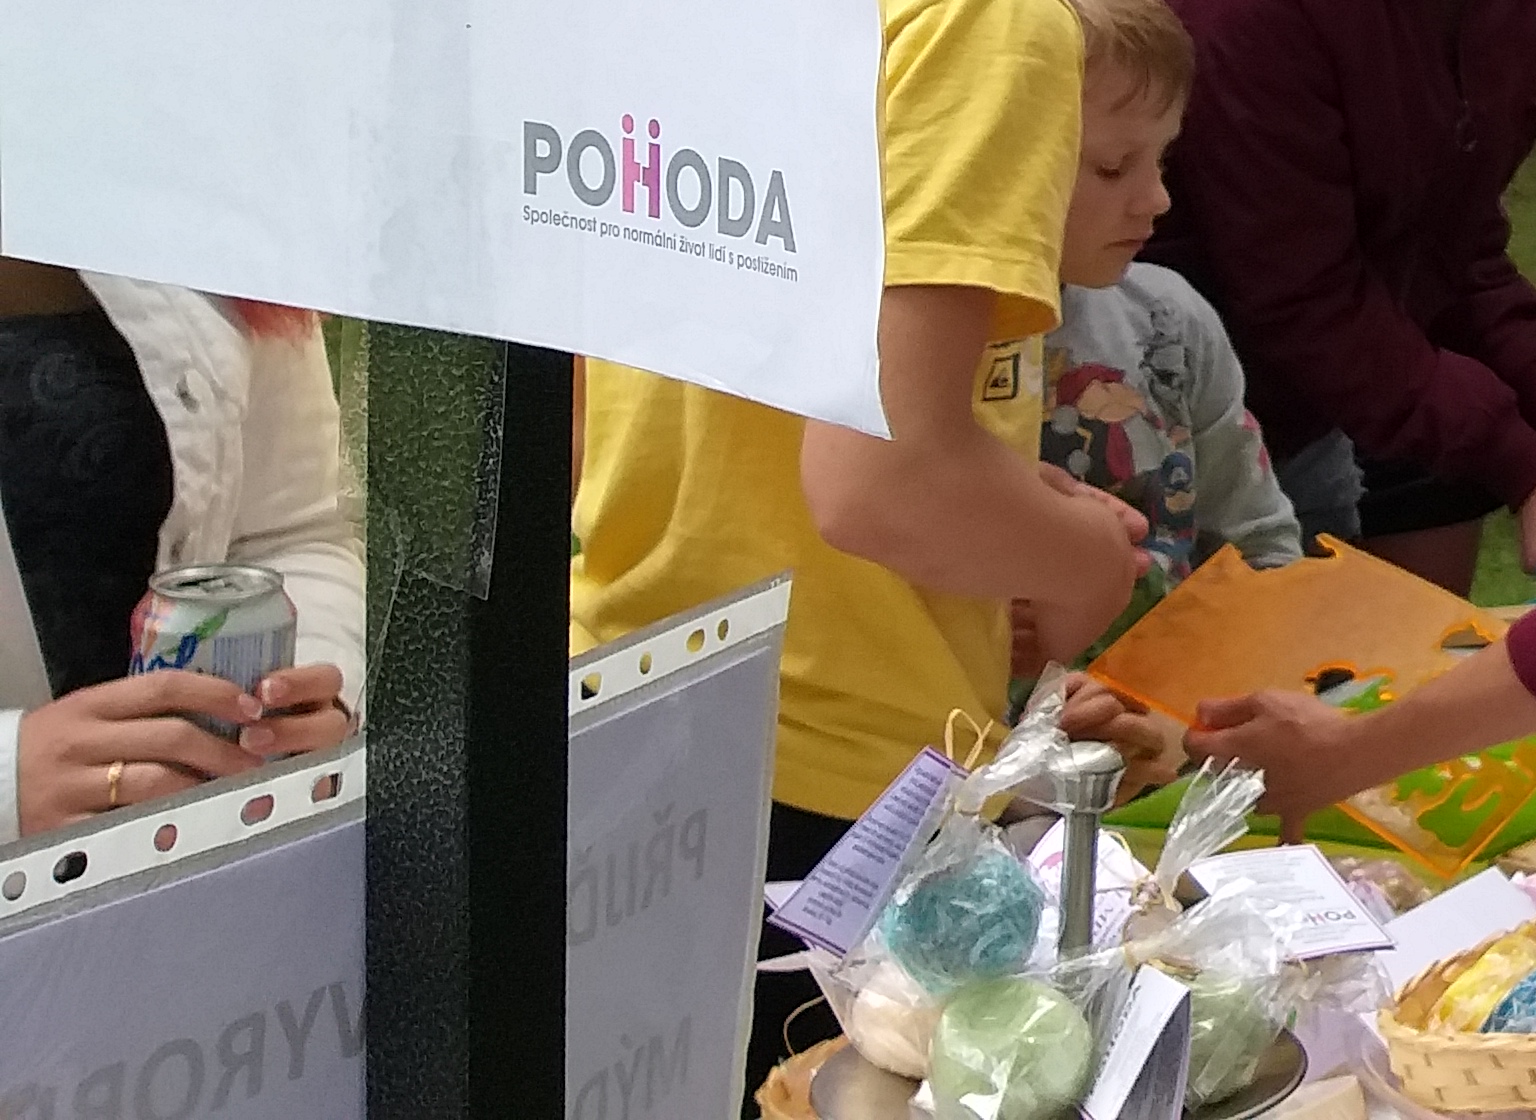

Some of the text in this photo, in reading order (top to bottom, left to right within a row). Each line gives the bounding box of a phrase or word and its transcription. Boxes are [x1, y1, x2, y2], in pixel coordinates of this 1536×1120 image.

[523, 113, 798, 254] POHODA
[522, 205, 799, 283] Společnost pro normální život lidí s postižením
